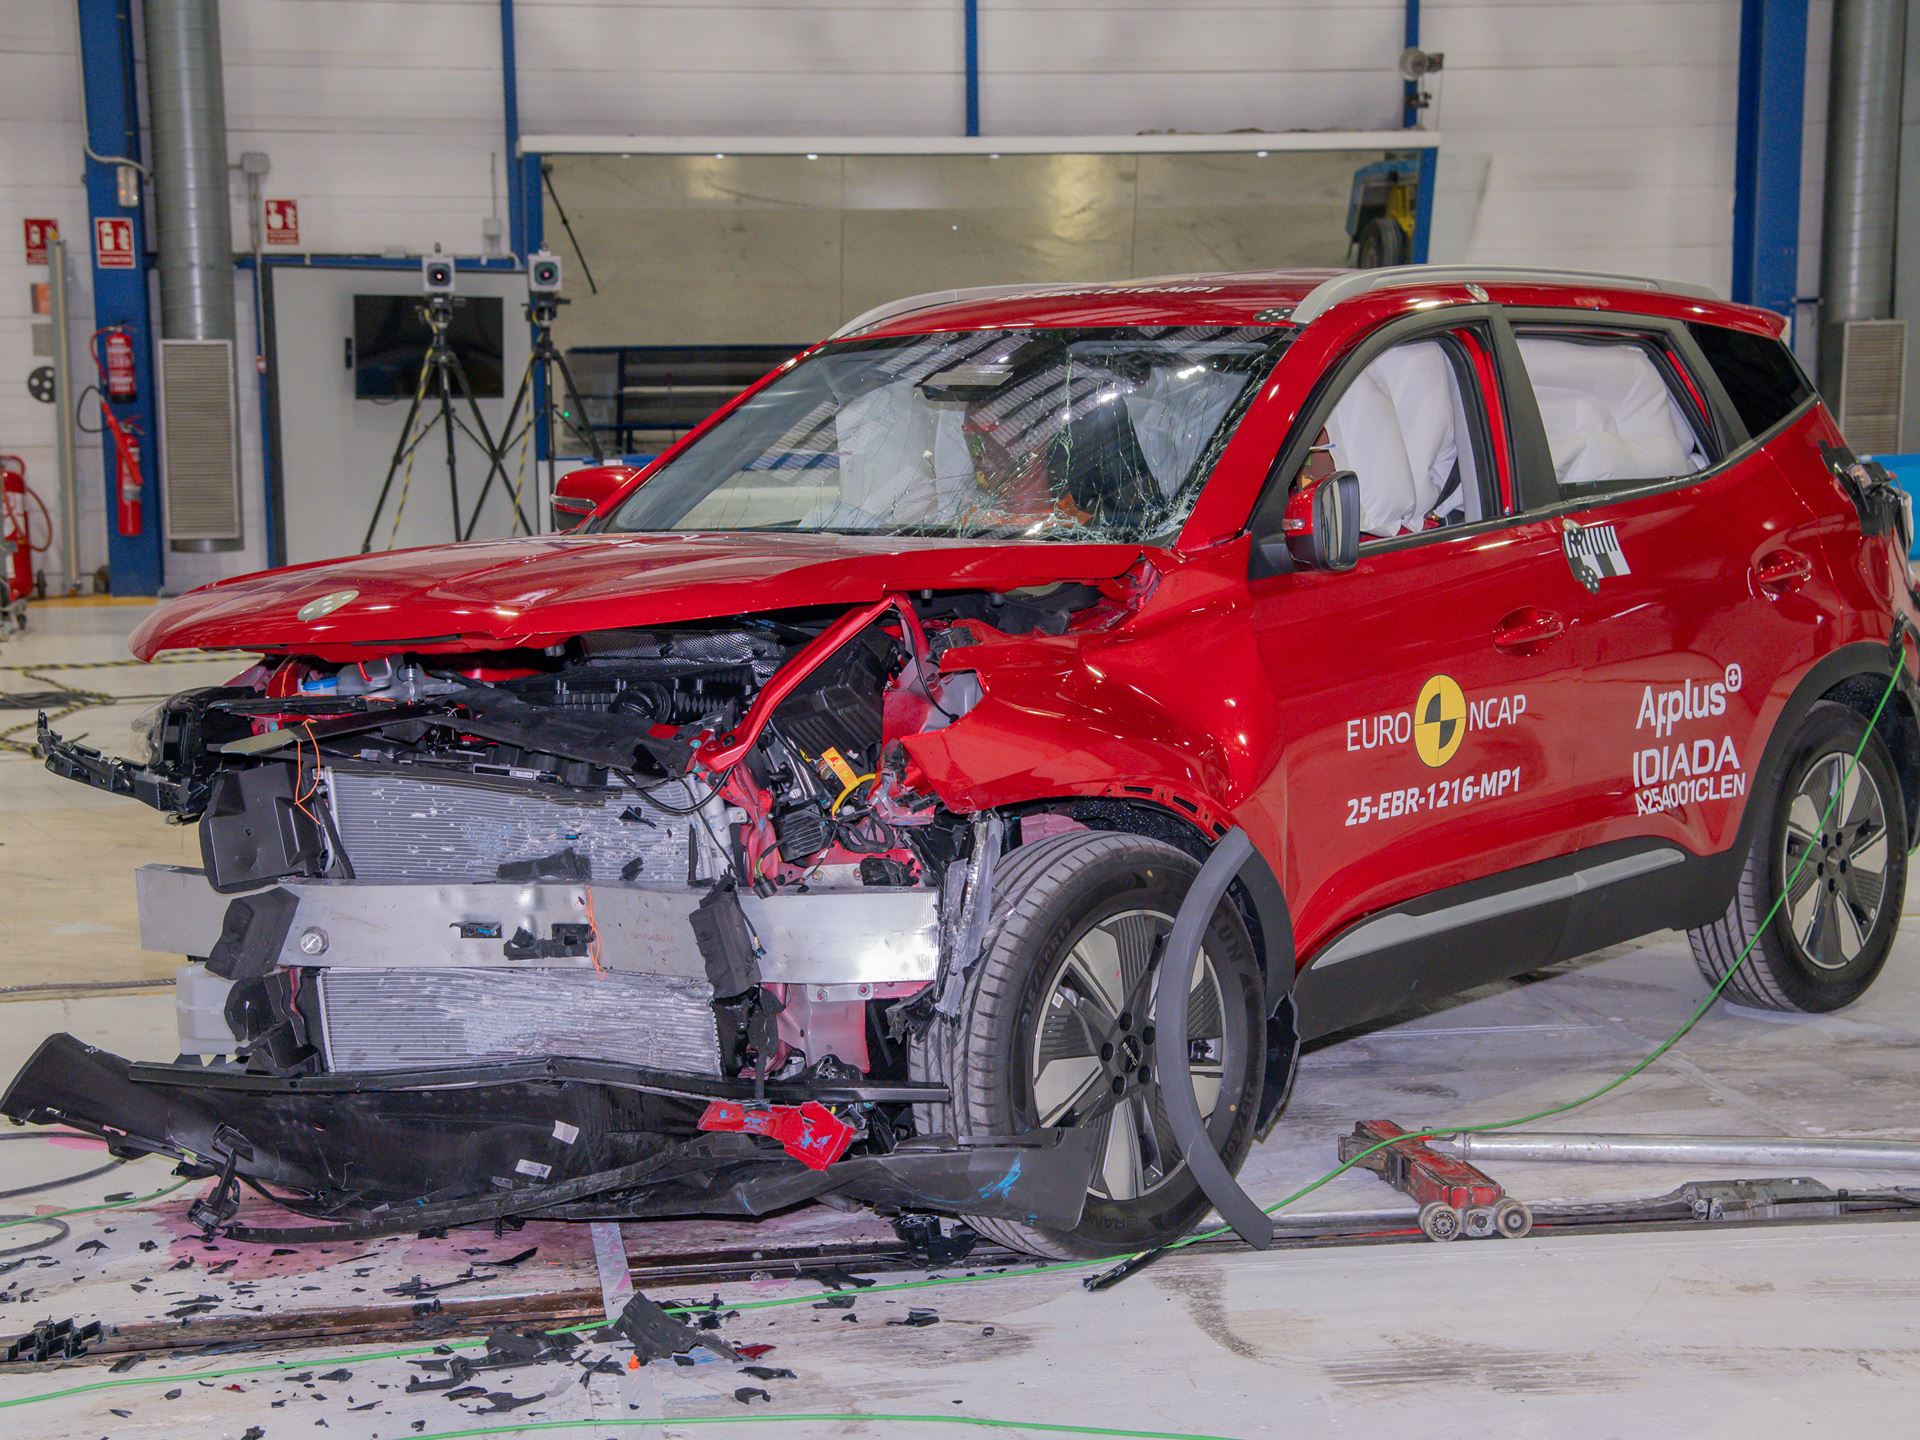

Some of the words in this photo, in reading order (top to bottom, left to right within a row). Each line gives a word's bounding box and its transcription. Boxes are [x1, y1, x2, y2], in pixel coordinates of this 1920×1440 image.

[1347, 711, 1412, 751] EURO
[1468, 694, 1527, 731] NCAP
[1633, 735, 1741, 788] IDIADA
[1345, 766, 1521, 827] 25-EBR-1216-MP1
[1634, 772, 1746, 817] A254001CLEN
